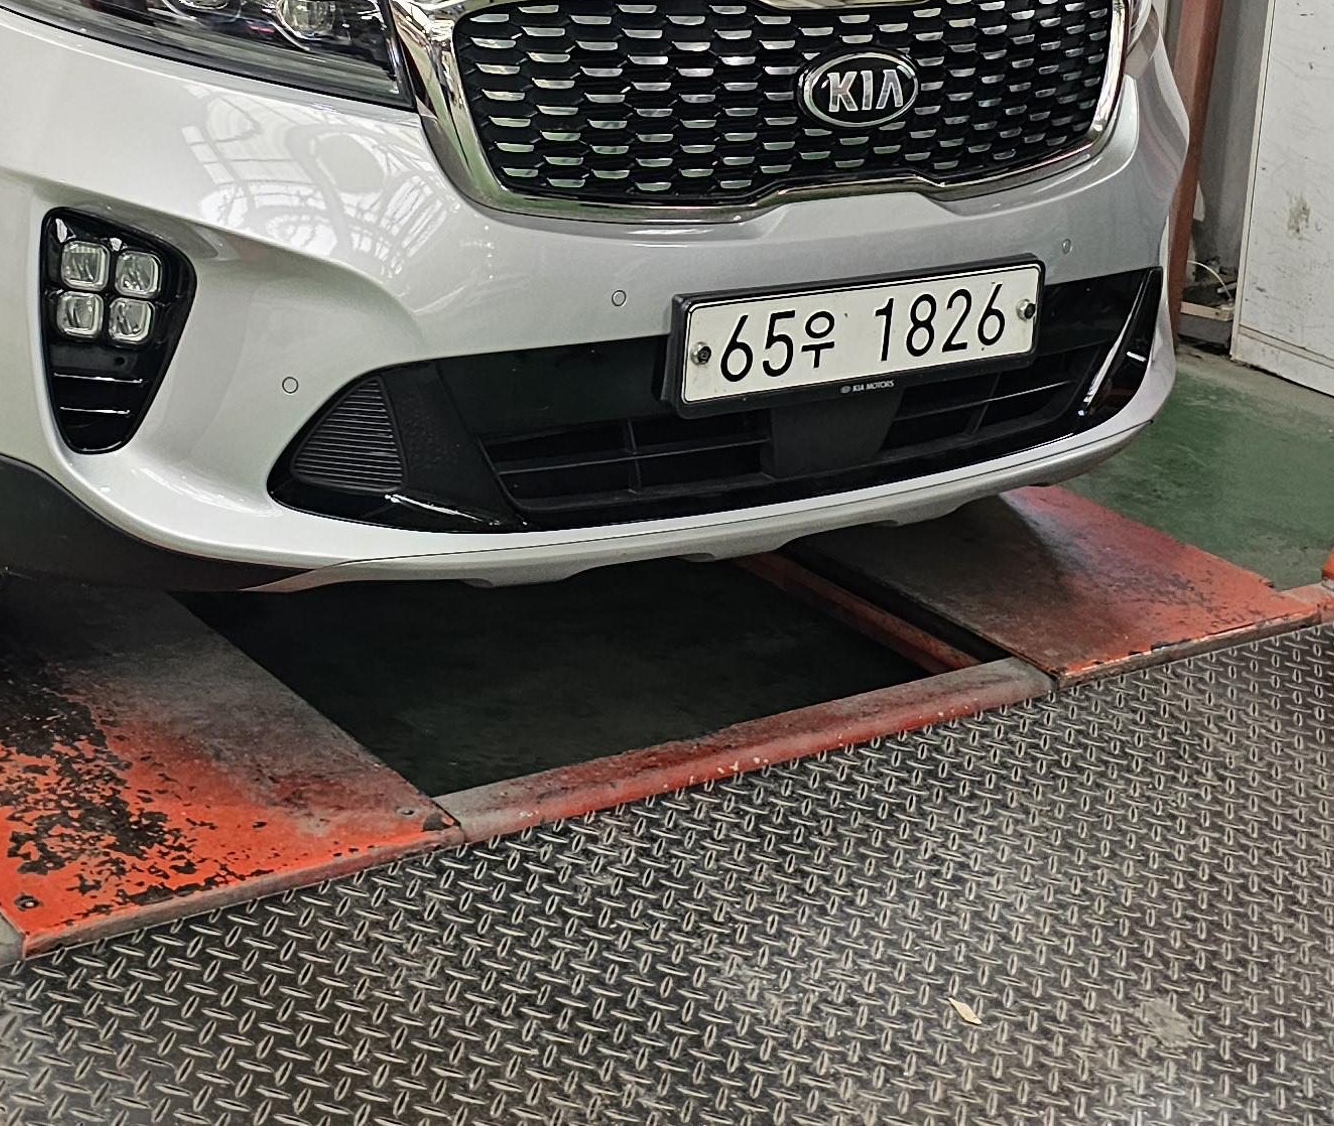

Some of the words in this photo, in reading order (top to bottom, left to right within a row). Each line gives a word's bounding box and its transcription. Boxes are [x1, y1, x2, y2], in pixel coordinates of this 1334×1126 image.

[827, 69, 904, 113] KIA
[720, 310, 835, 383] 65우
[874, 282, 1007, 362] 1826
